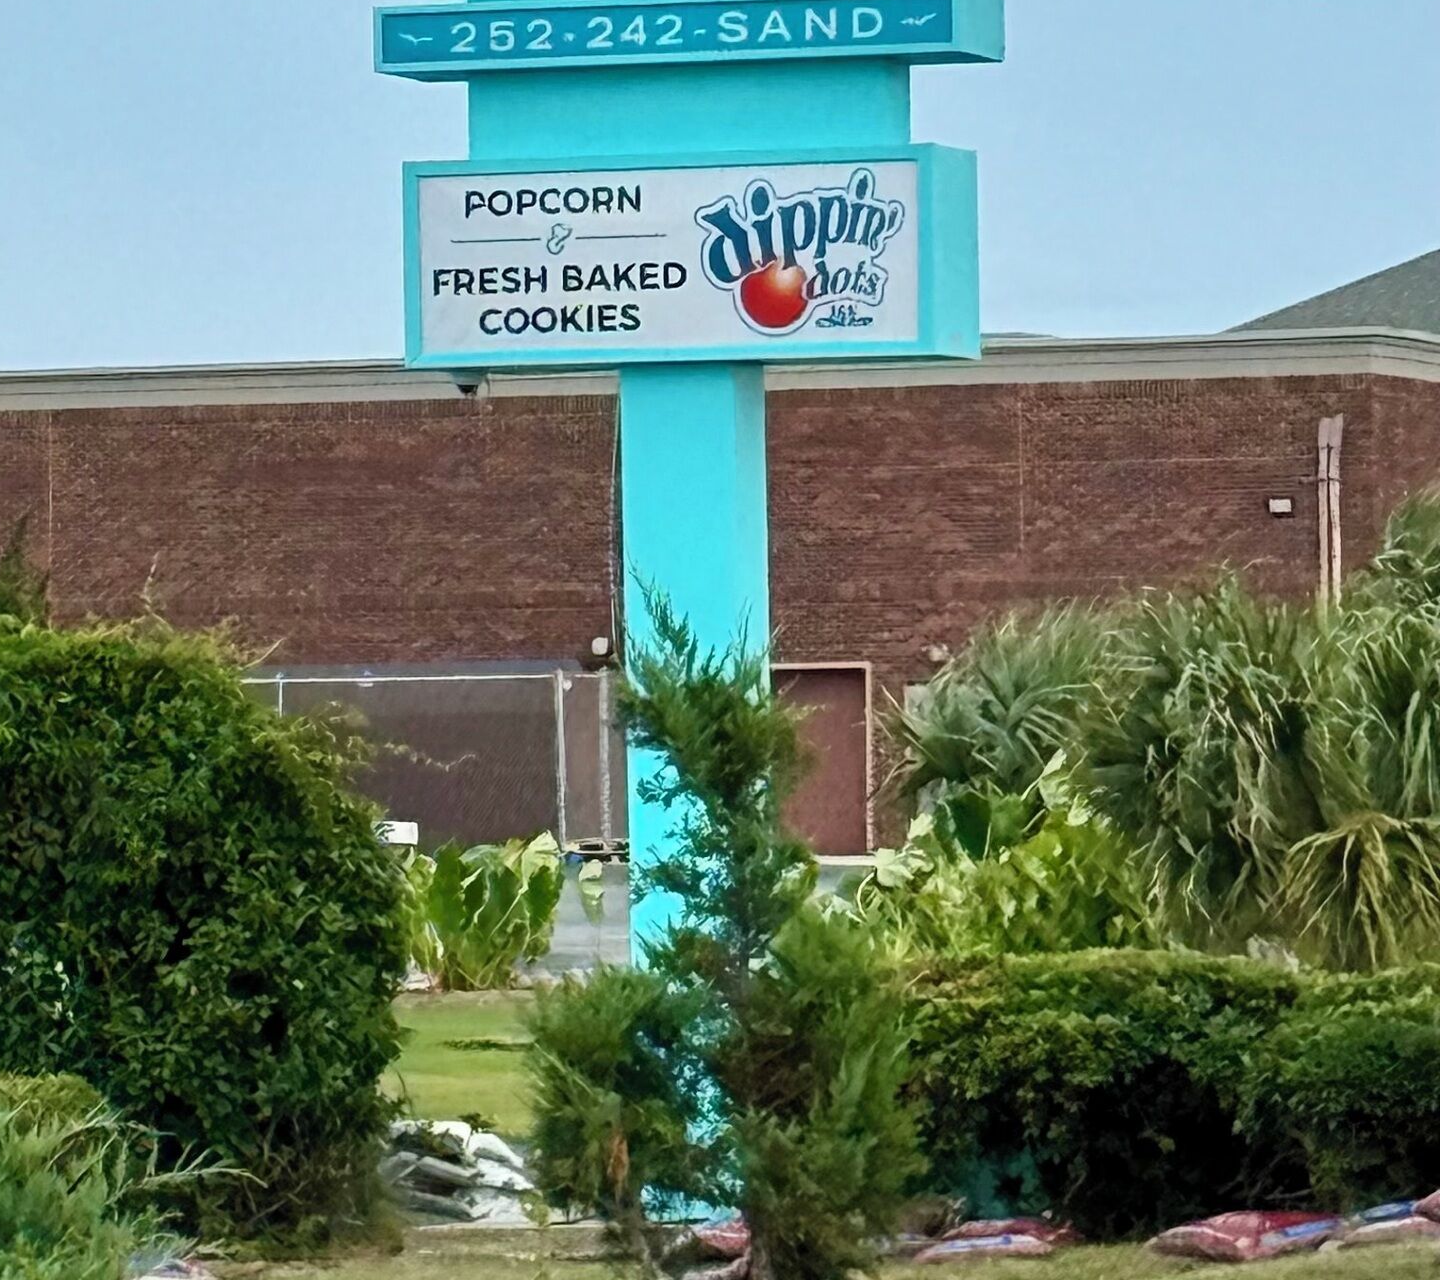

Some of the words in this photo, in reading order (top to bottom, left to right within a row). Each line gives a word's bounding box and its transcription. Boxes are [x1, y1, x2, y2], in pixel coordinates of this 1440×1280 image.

[465, 185, 642, 218] POPCORN
[547, 224, 572, 255] &
[433, 266, 547, 296] FRESH
[562, 262, 687, 291] BAKED
[807, 260, 880, 299] dots
[479, 304, 641, 334] COOKIES
